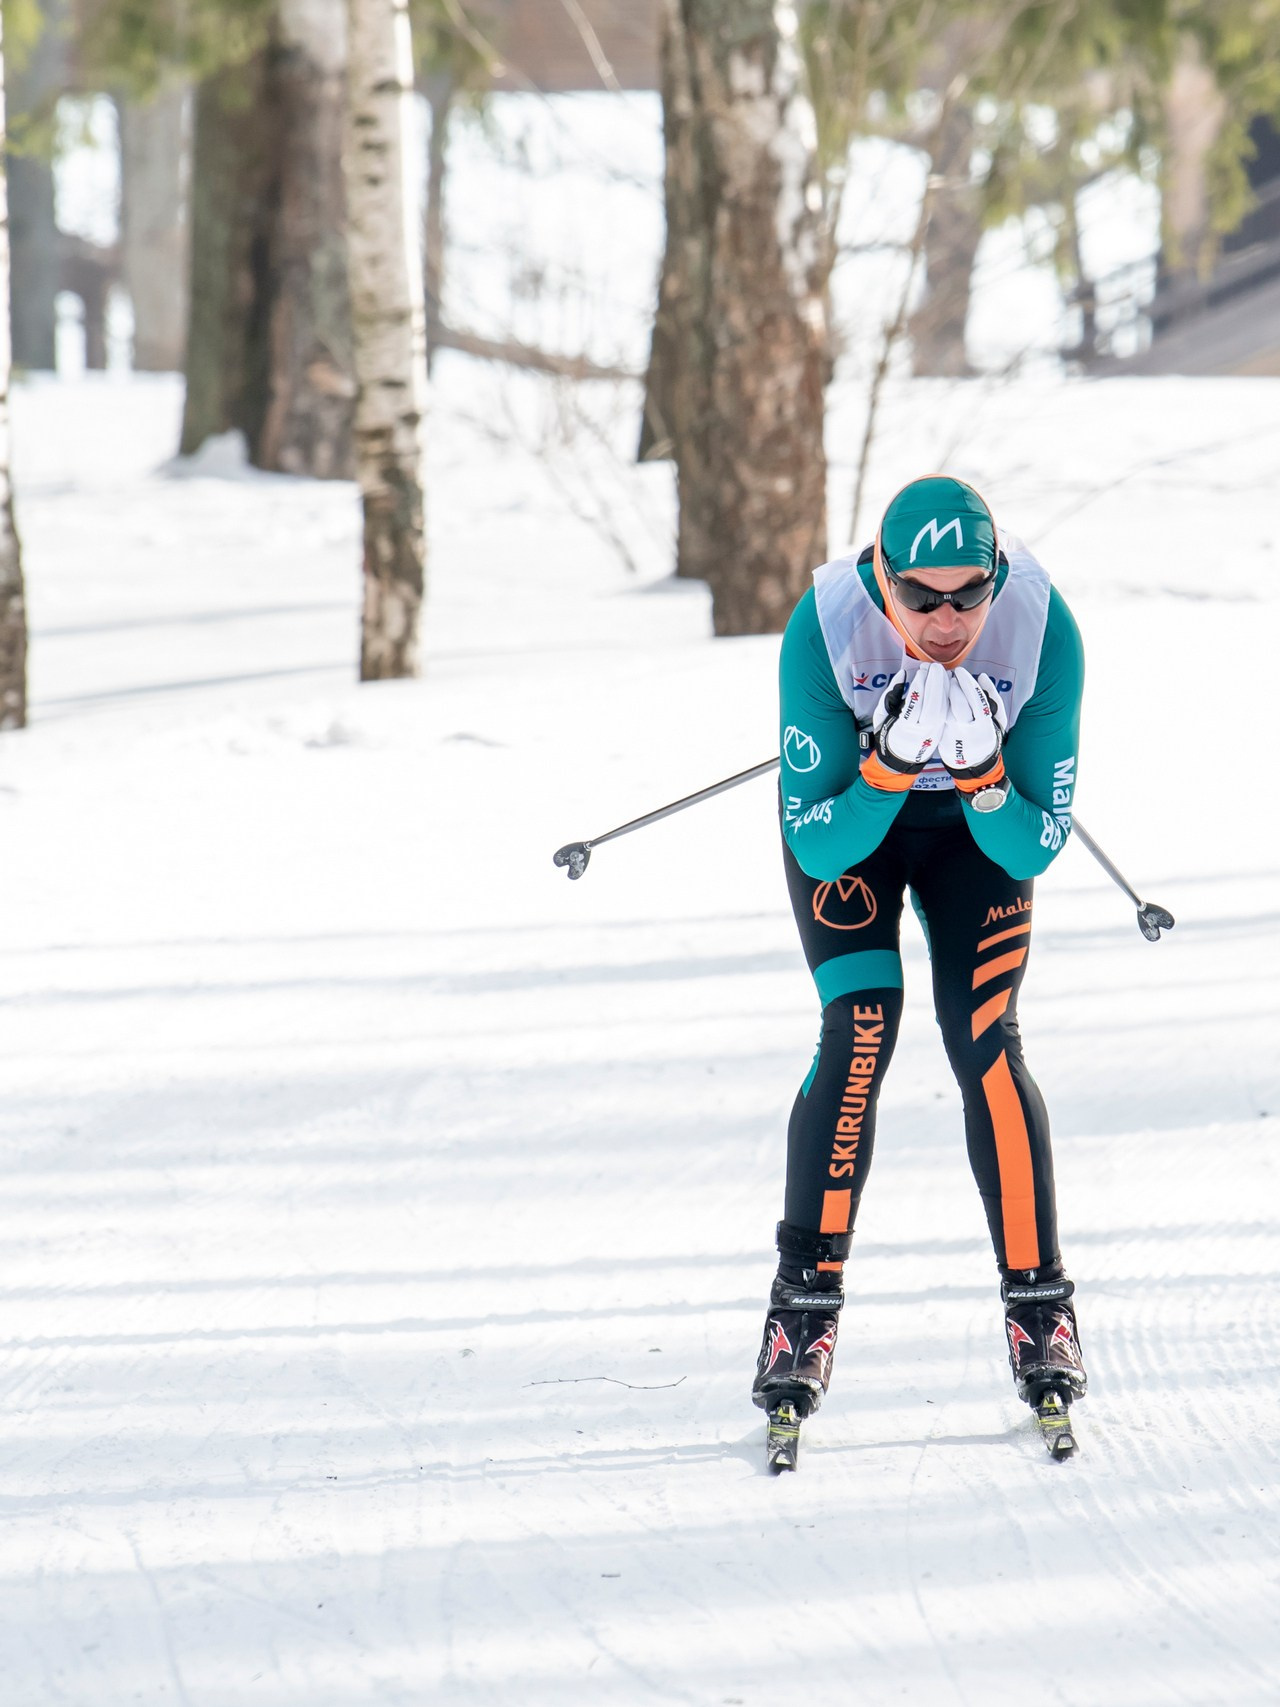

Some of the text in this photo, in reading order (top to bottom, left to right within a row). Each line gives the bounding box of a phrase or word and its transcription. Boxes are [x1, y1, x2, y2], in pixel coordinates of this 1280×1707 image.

[918, 776, 953, 784] фести
[981, 897, 1033, 927] Male
[829, 1004, 884, 1179] SKIRUNBIKE
[1007, 1287, 1065, 1298] MADSHUS
[791, 1297, 842, 1305] MADSHU
